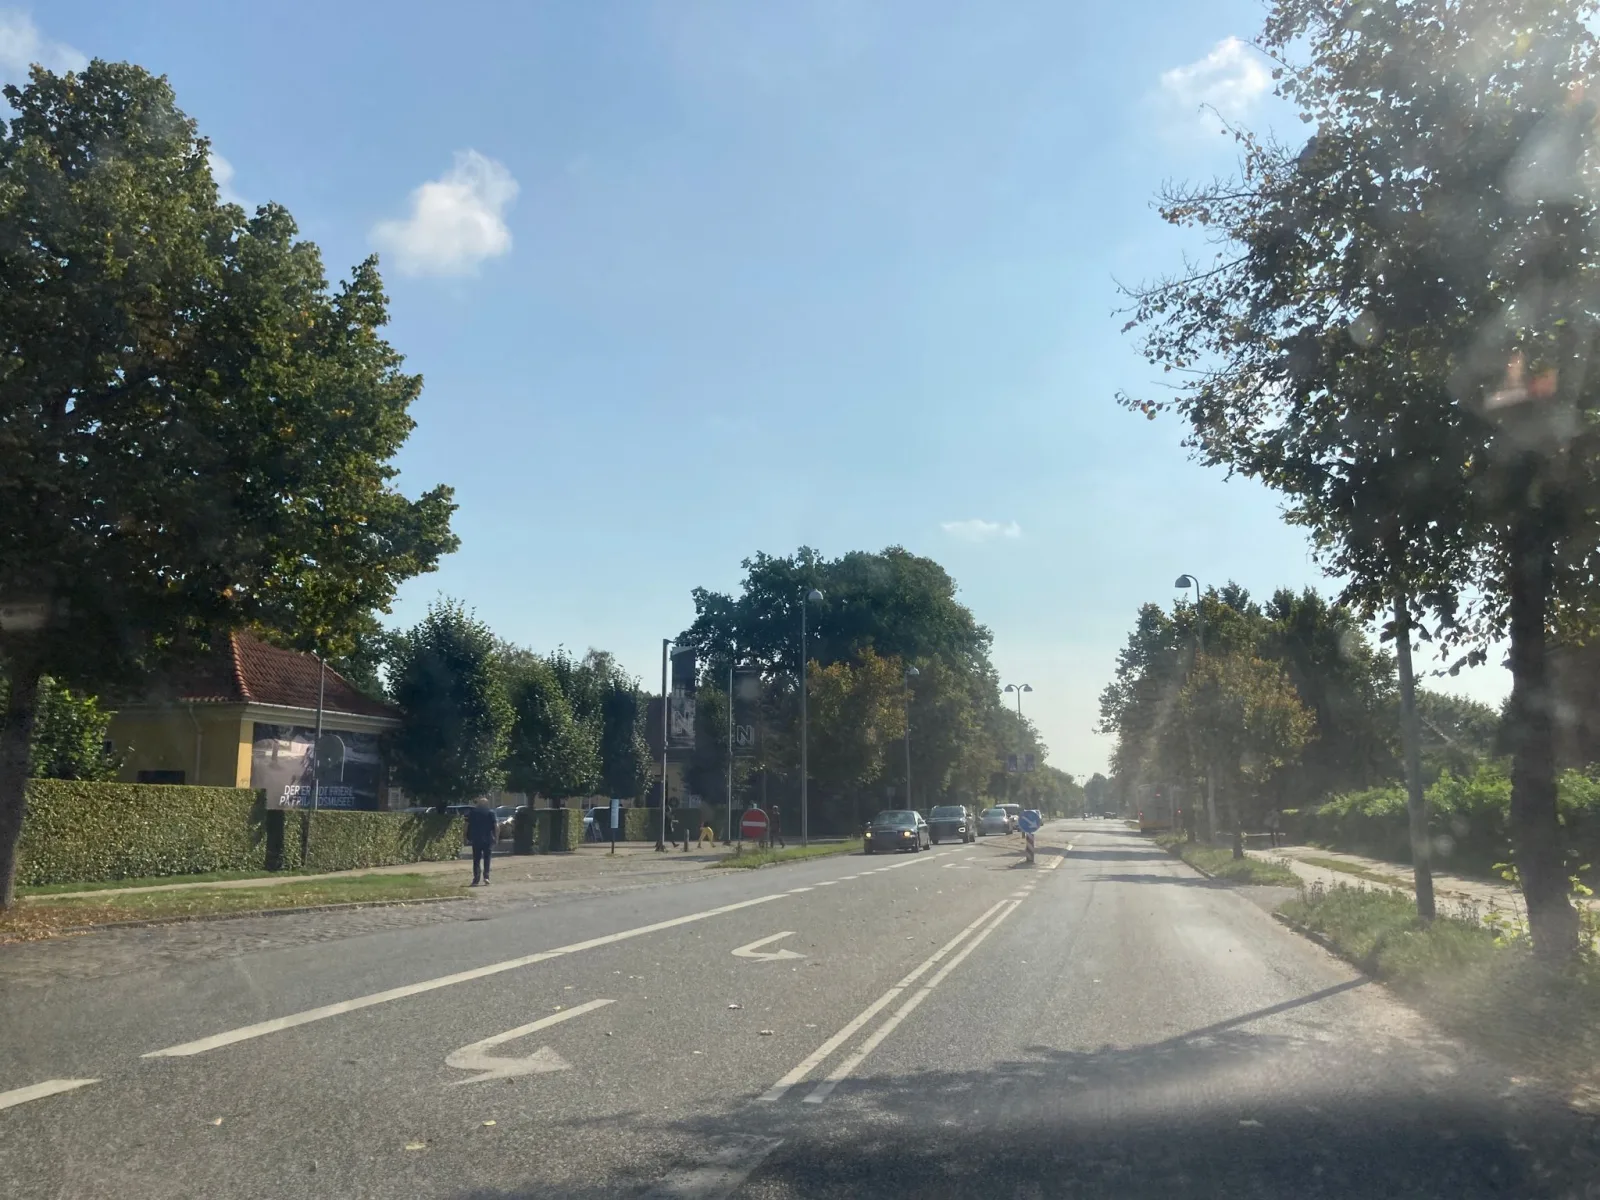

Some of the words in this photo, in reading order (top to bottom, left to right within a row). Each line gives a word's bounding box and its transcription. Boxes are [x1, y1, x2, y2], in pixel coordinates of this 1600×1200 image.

[674, 710, 694, 734] N
[736, 725, 755, 746] N
[284, 785, 300, 795] DER
[301, 786, 311, 796] ER
[279, 795, 290, 806] PÅ
